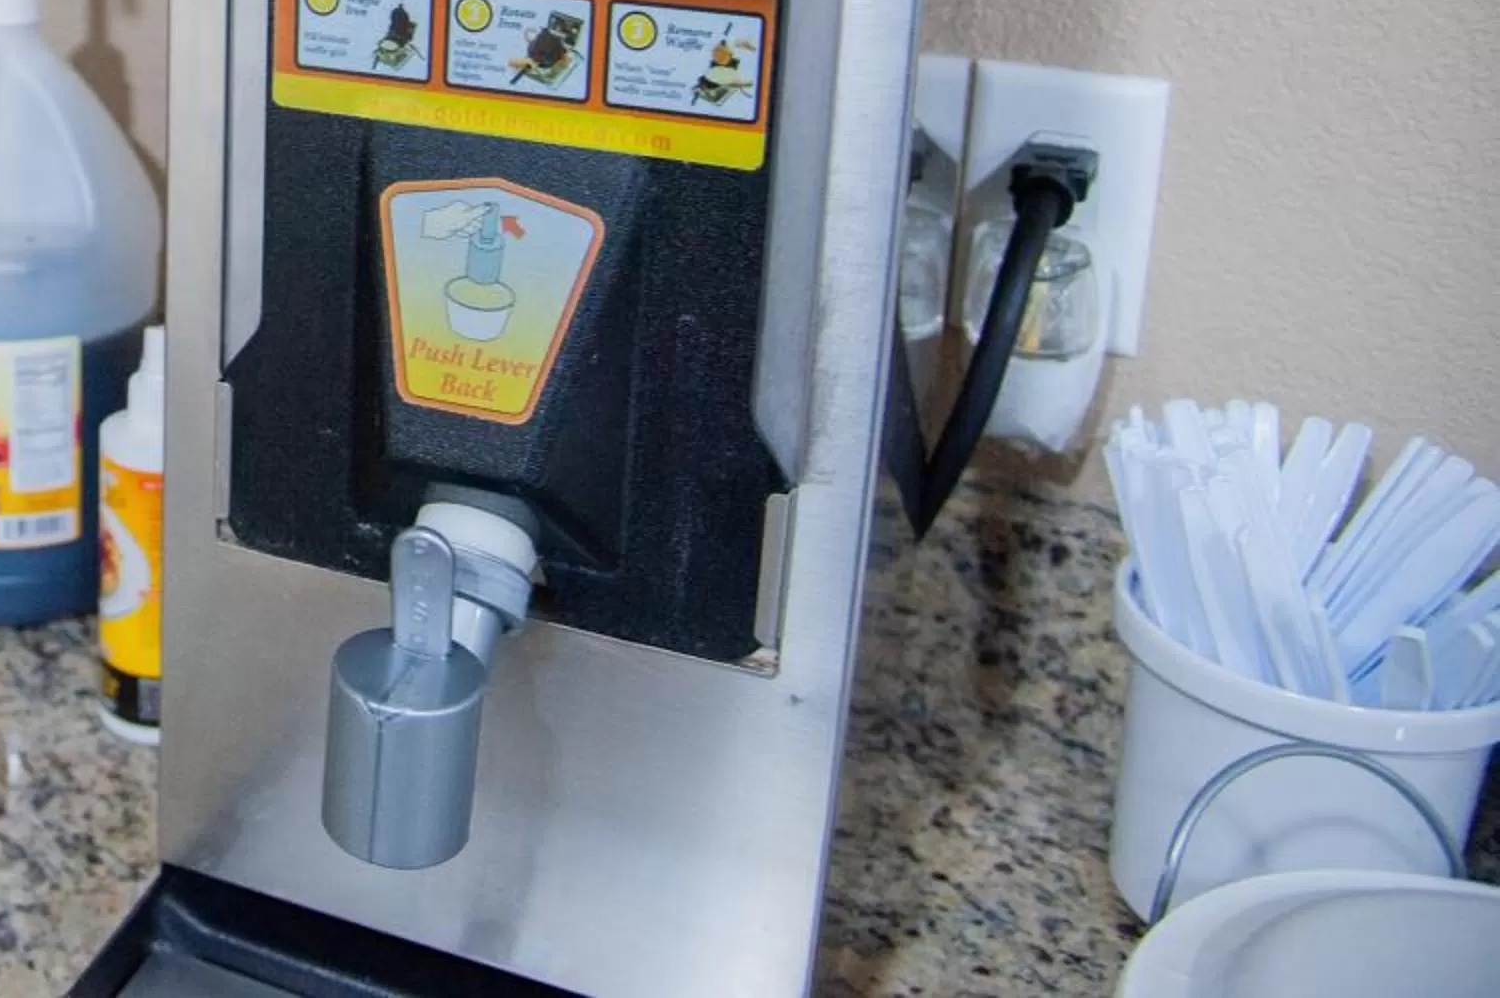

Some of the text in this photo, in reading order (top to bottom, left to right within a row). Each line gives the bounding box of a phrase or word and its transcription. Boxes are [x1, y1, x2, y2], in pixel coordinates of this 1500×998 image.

[667, 22, 713, 38] Remove
[408, 337, 538, 379] Push Lever
[440, 372, 499, 402] Back
